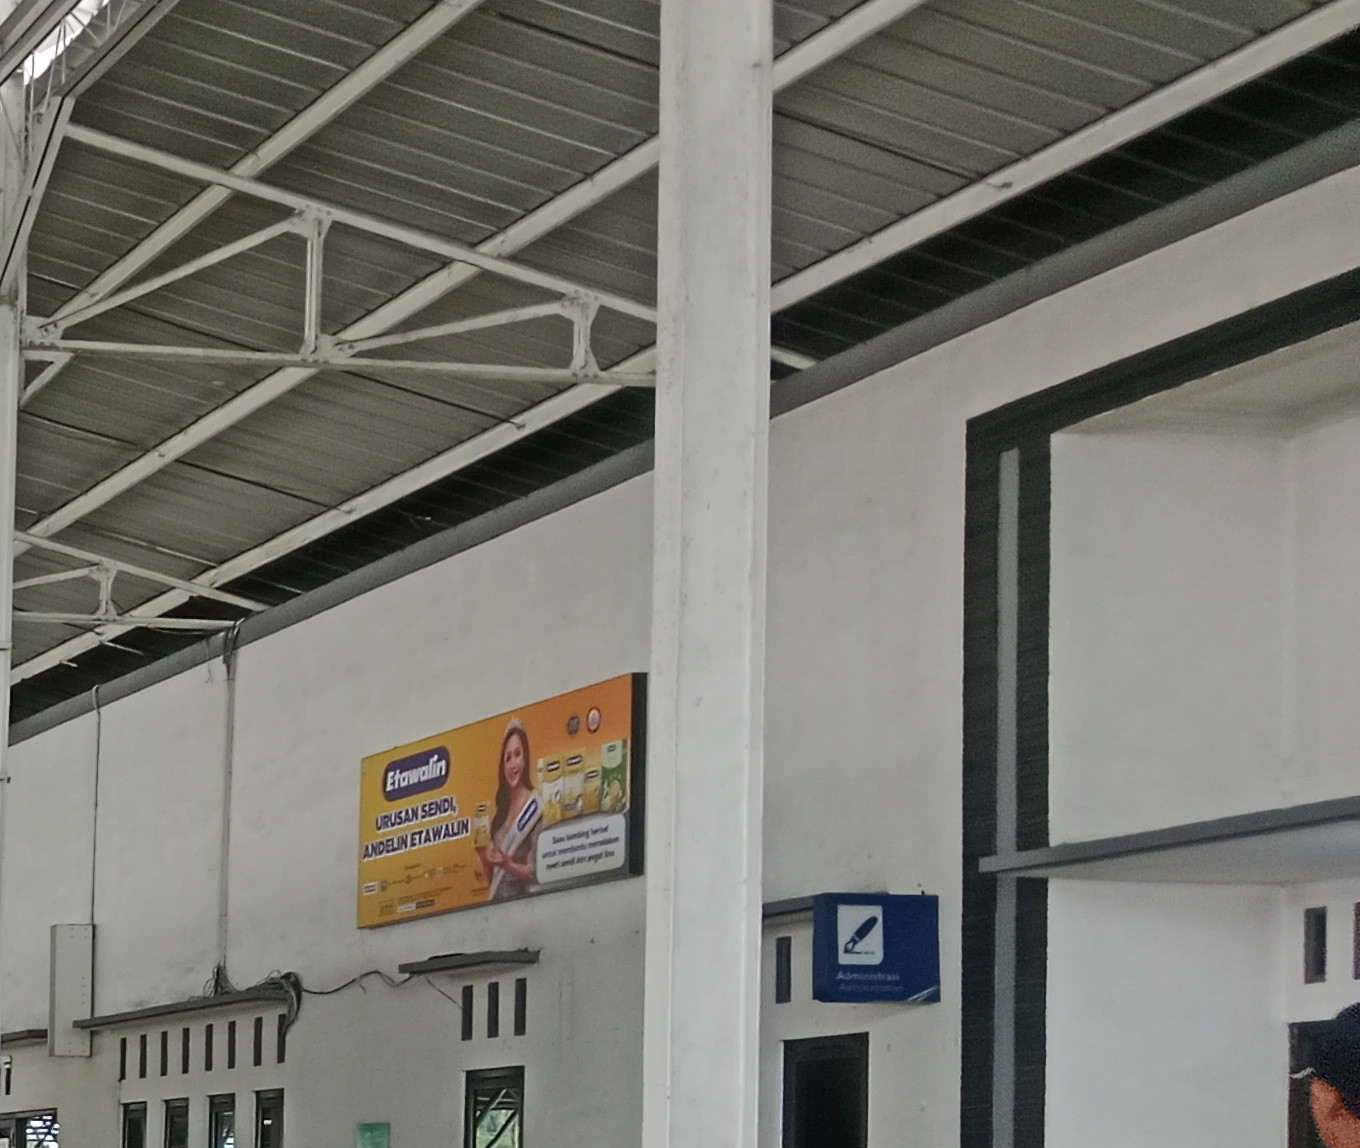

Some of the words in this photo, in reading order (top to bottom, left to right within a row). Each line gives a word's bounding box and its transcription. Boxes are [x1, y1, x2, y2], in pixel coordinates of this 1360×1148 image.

[385, 754, 447, 792] Etawalin
[375, 805, 419, 831] URUSAN
[420, 796, 457, 820] SENDI,
[362, 833, 409, 859] ANDELIN
[409, 818, 470, 848] ETAWALIN
